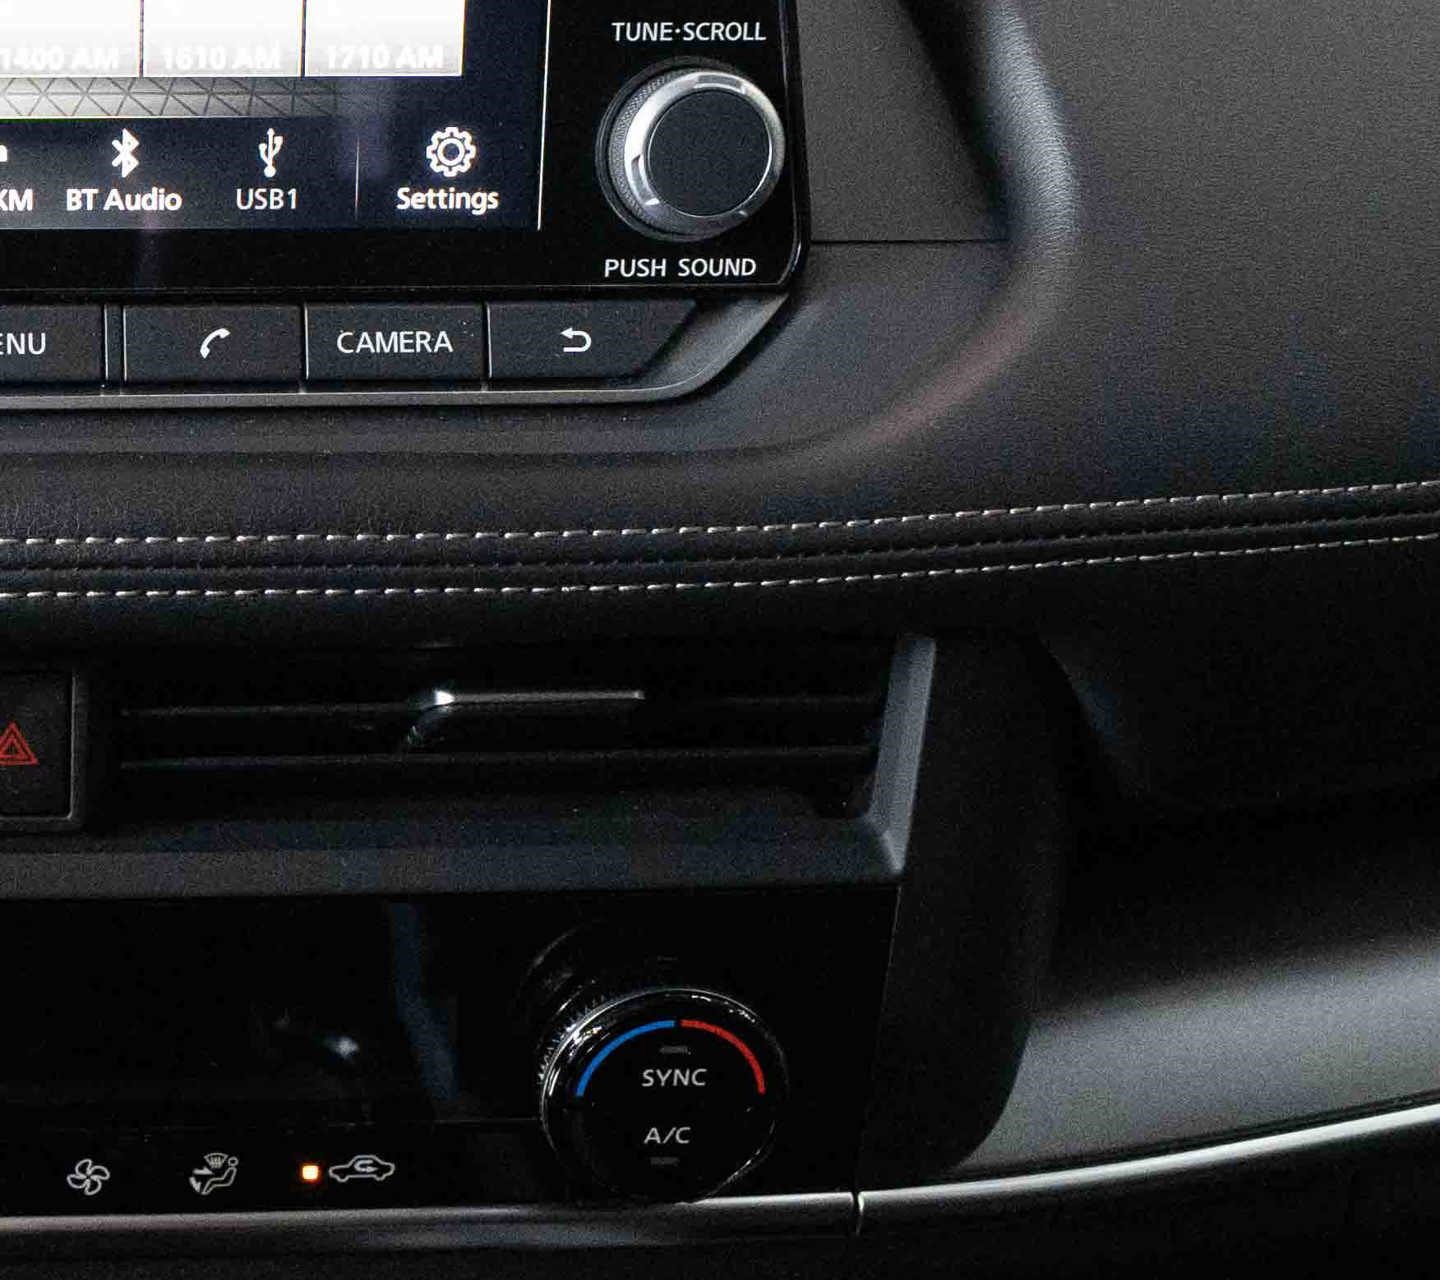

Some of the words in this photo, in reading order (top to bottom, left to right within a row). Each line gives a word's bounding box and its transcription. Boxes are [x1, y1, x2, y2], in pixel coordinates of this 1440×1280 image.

[70, 47, 120, 70] AM
[233, 46, 281, 70] AM
[327, 46, 388, 70] 1710
[396, 46, 444, 69] AM
[66, 189, 97, 211] BT
[104, 187, 182, 211] Audio
[236, 189, 298, 210] USB1
[396, 188, 499, 215] Settings
[604, 259, 666, 278] PUSH
[678, 258, 756, 277] SOUND
[337, 330, 453, 354] CAMERA
[641, 1068, 707, 1087] SYNC
[644, 1127, 691, 1144] A/C
